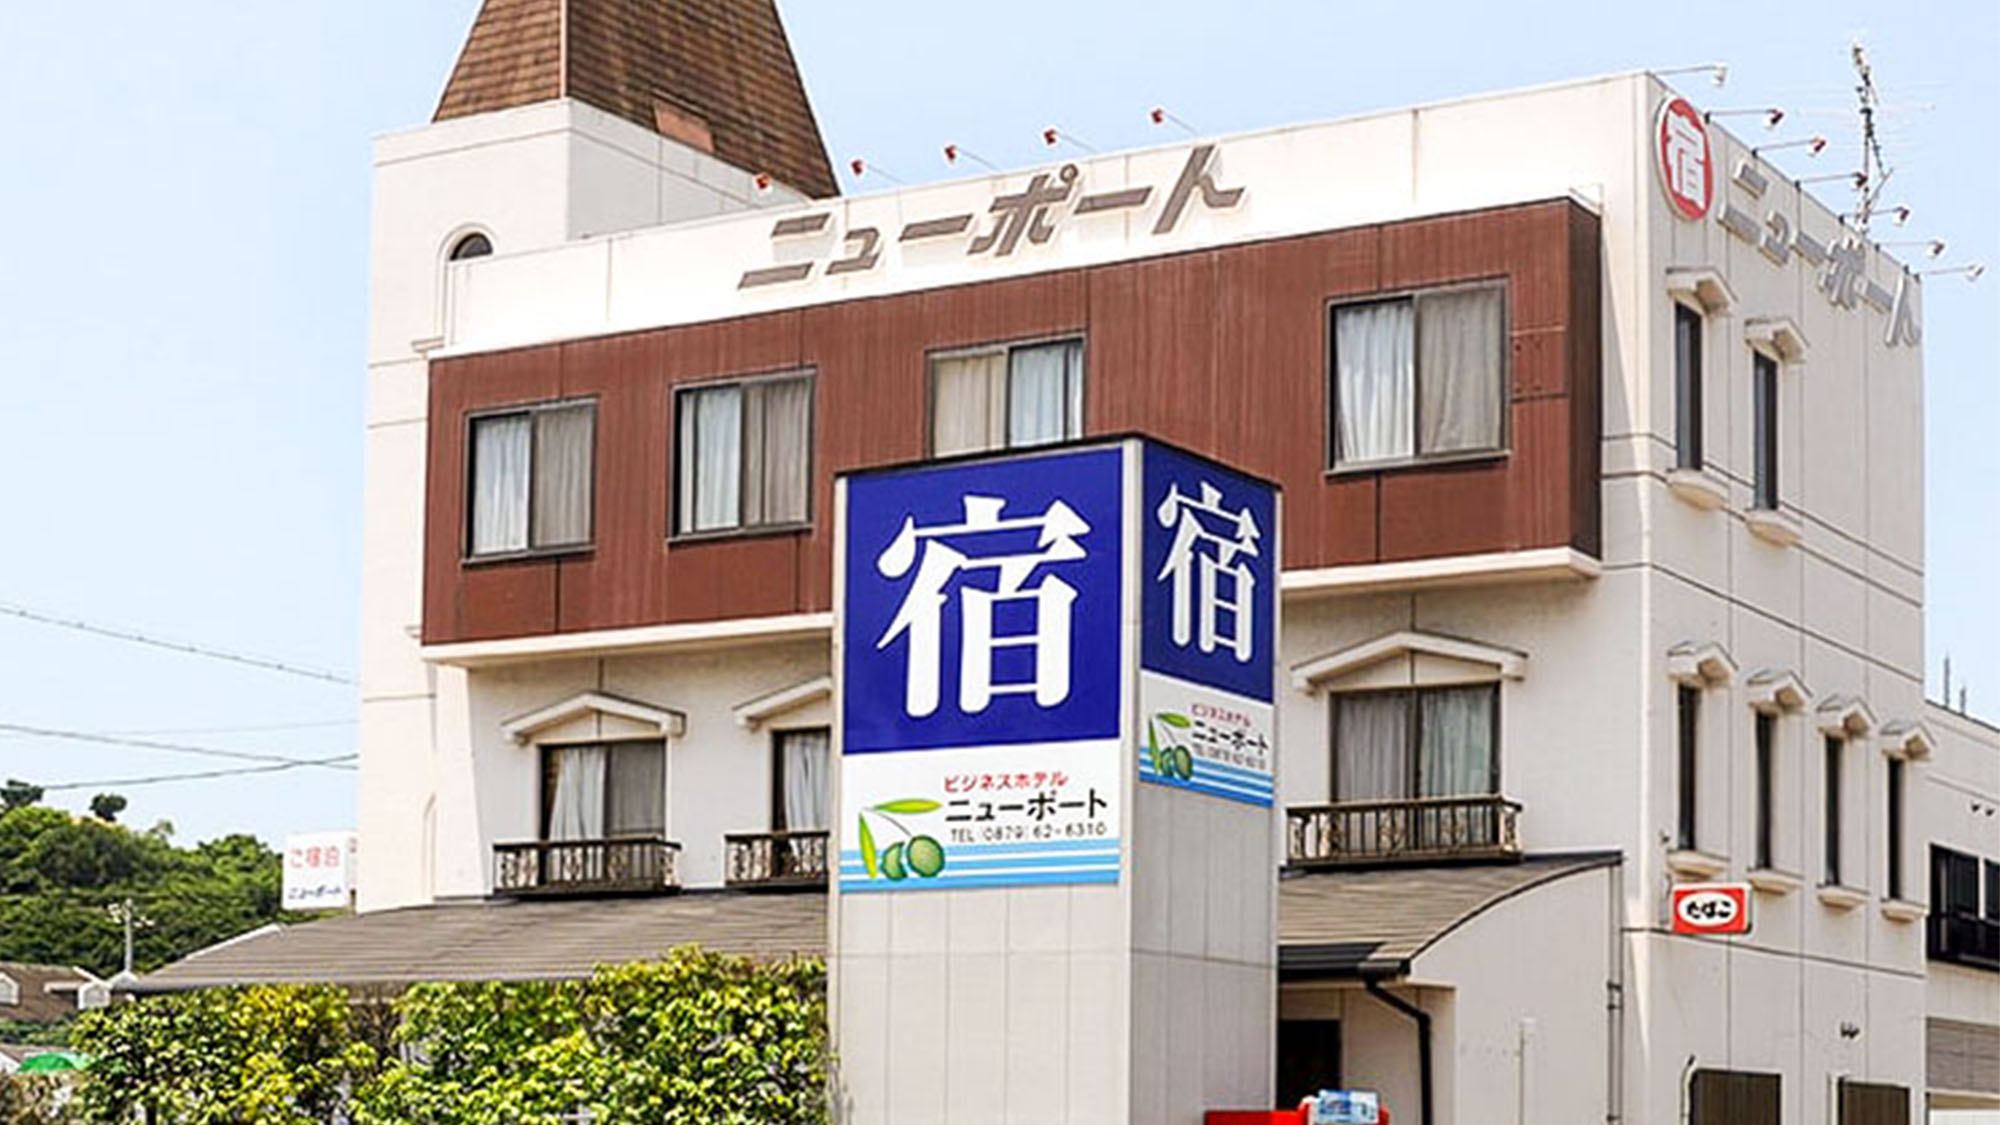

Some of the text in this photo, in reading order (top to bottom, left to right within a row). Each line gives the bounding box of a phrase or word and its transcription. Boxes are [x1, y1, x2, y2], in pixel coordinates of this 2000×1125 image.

[738, 145, 1244, 289] ニューポート
[1717, 159, 1921, 346] ニューポート
[877, 494, 1091, 718] 宿
[1157, 480, 1260, 663] 宿
[945, 772, 1068, 792] ビジネスホテル
[945, 788, 1107, 821] ニューポート
[951, 828, 974, 842] TEL
[1033, 821, 1107, 838] 62-6310
[1686, 901, 1731, 919] たばこ
